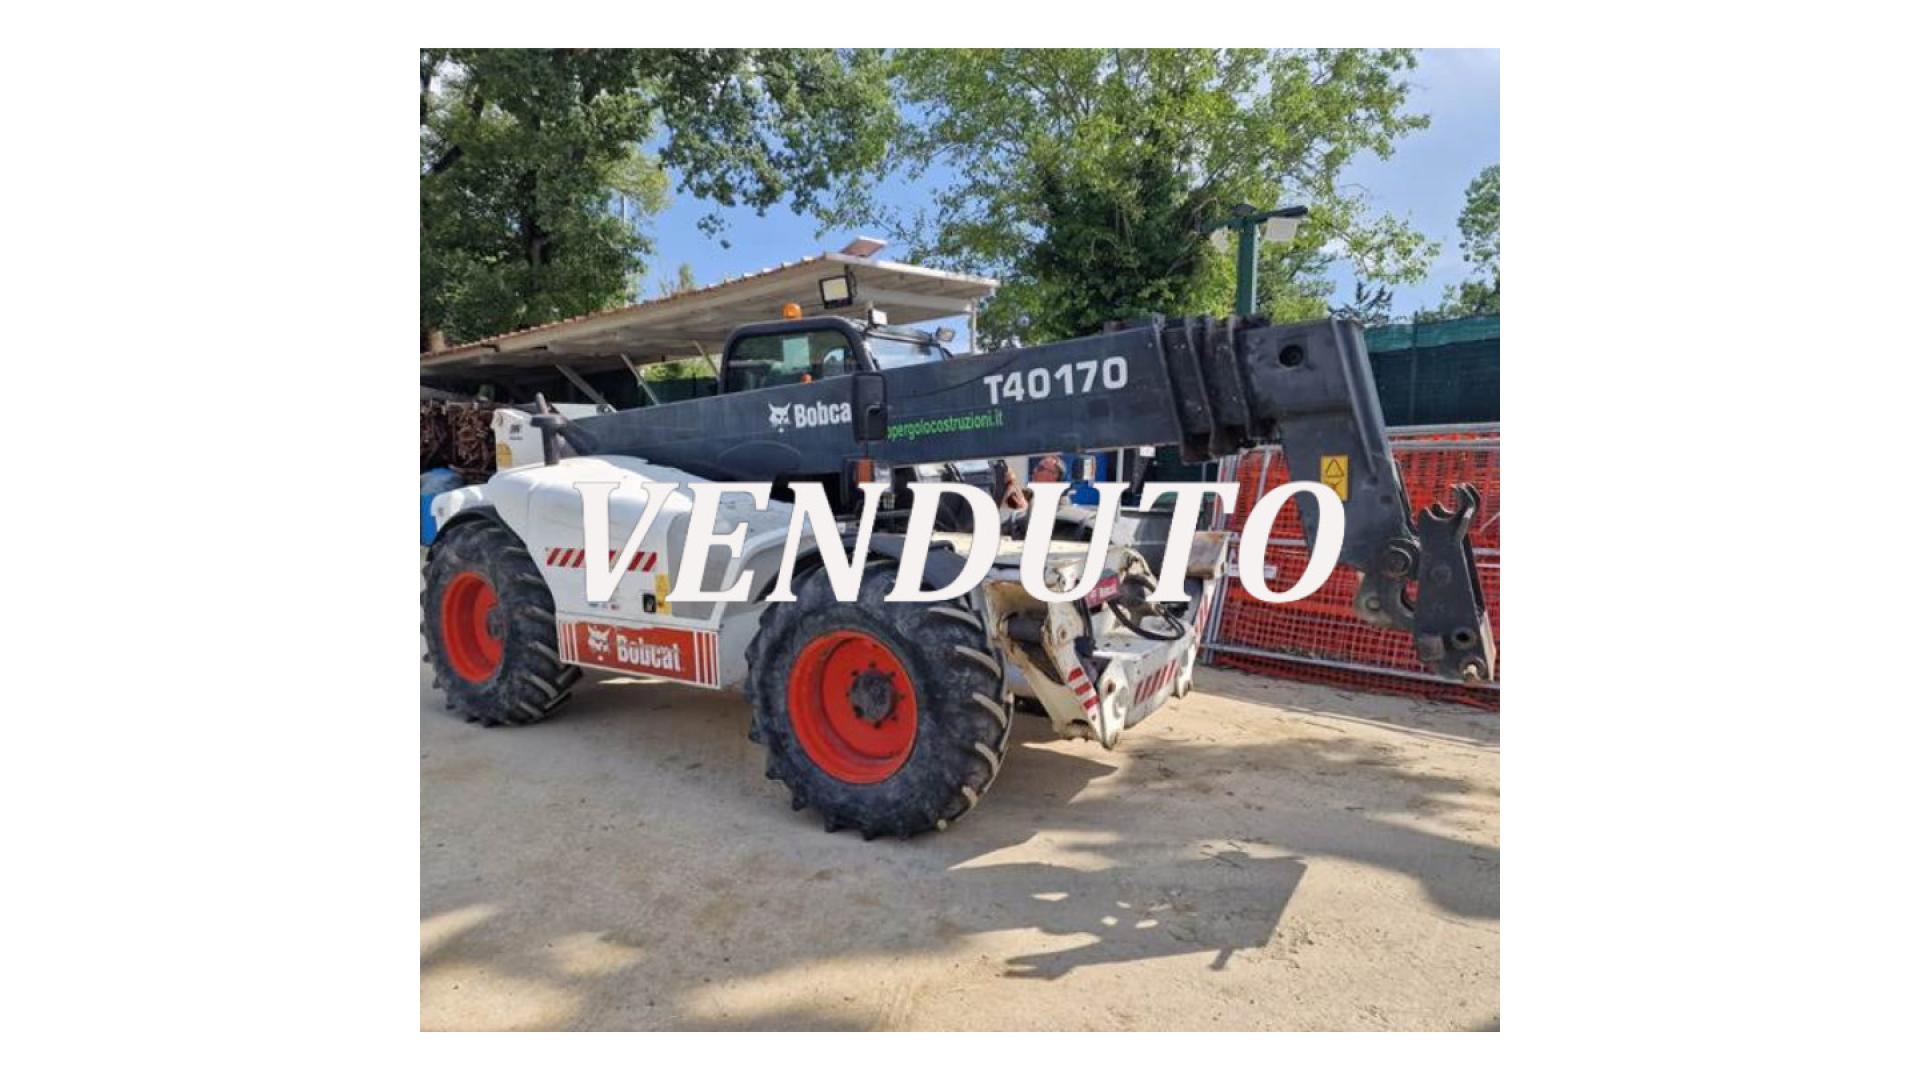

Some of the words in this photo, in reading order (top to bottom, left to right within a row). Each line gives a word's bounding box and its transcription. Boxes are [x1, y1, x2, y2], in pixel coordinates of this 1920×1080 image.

[984, 356, 1128, 405] T40170
[794, 400, 852, 428] Bobca
[616, 634, 681, 672] Bobcat
